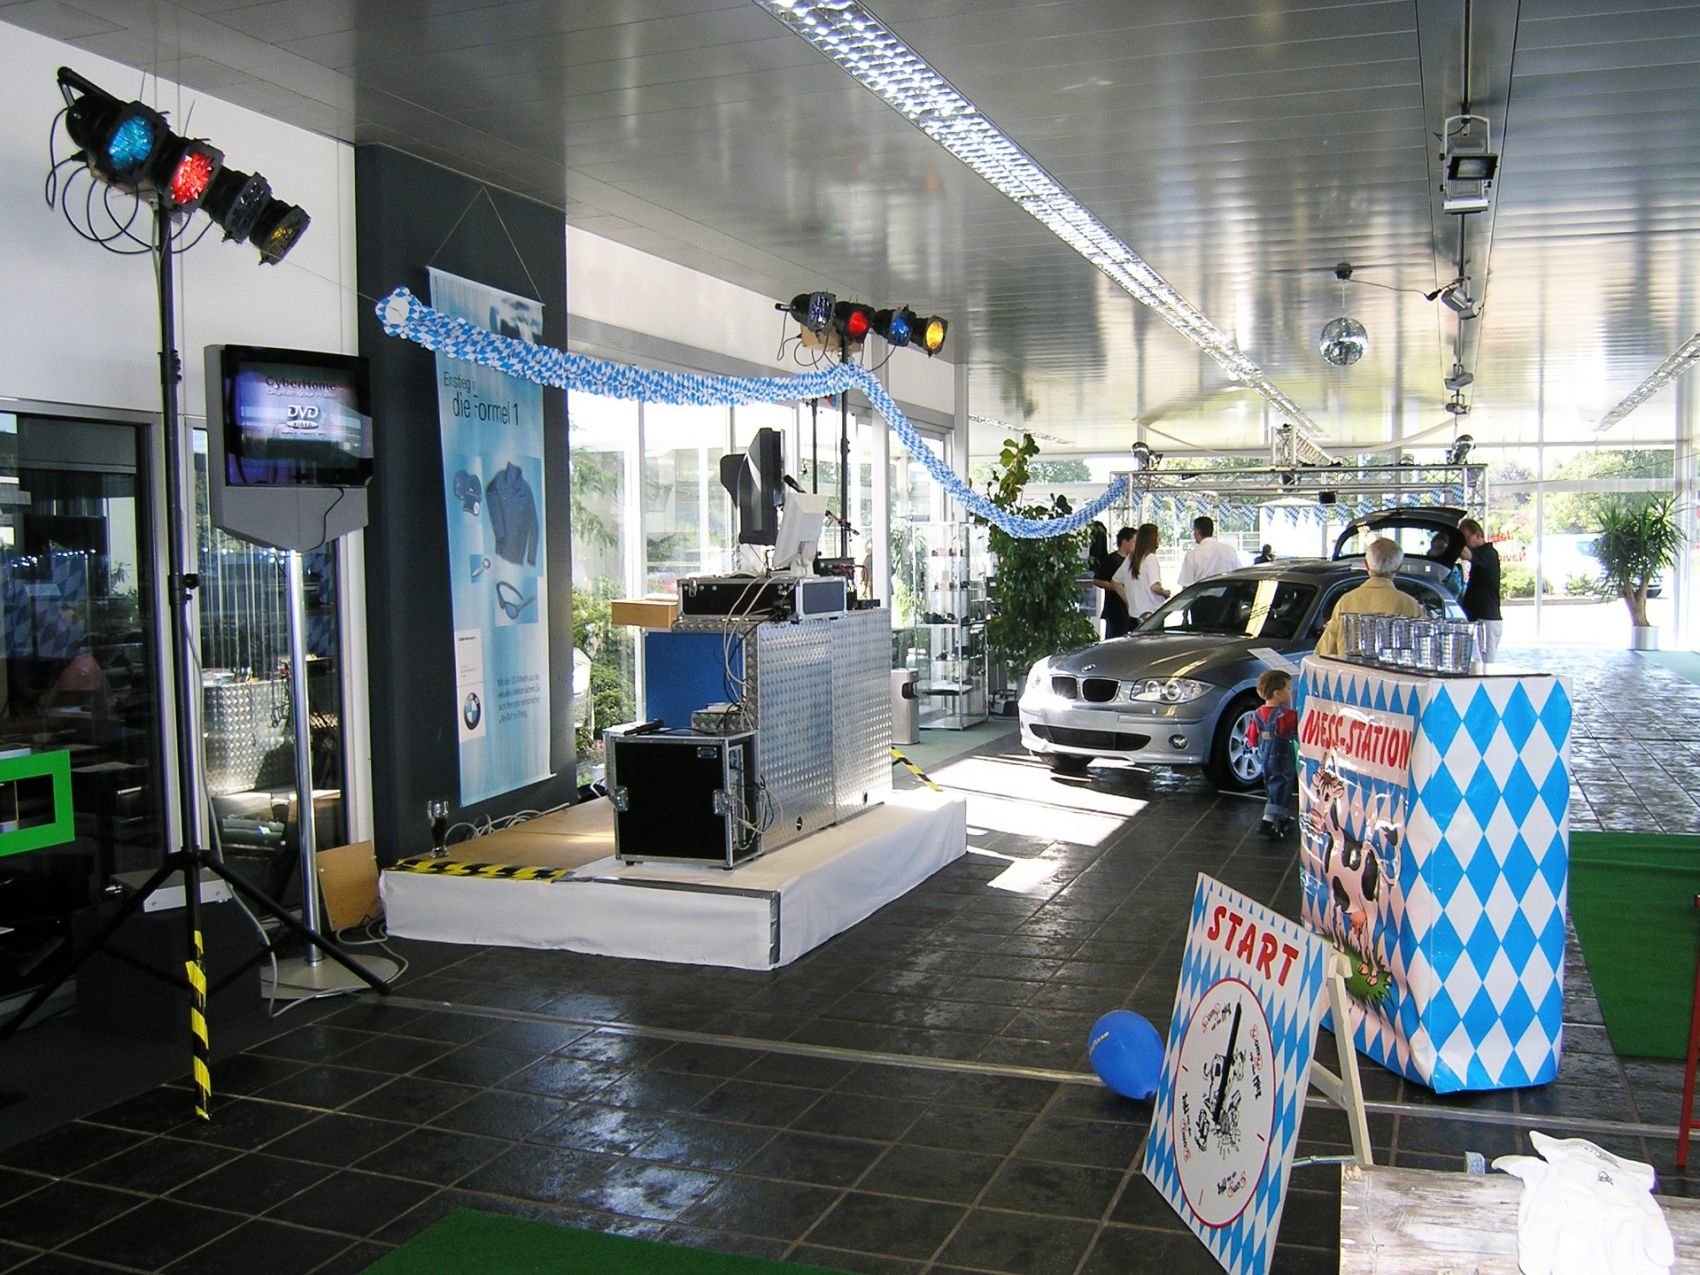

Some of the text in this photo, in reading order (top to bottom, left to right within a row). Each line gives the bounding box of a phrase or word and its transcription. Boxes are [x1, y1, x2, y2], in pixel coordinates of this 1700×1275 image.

[265, 376, 337, 391] CyberHome
[287, 404, 319, 419] DVD
[453, 391, 471, 418] die
[513, 402, 519, 426] 1
[1302, 709, 1413, 771] MESS-STATION
[1207, 905, 1299, 987] START
